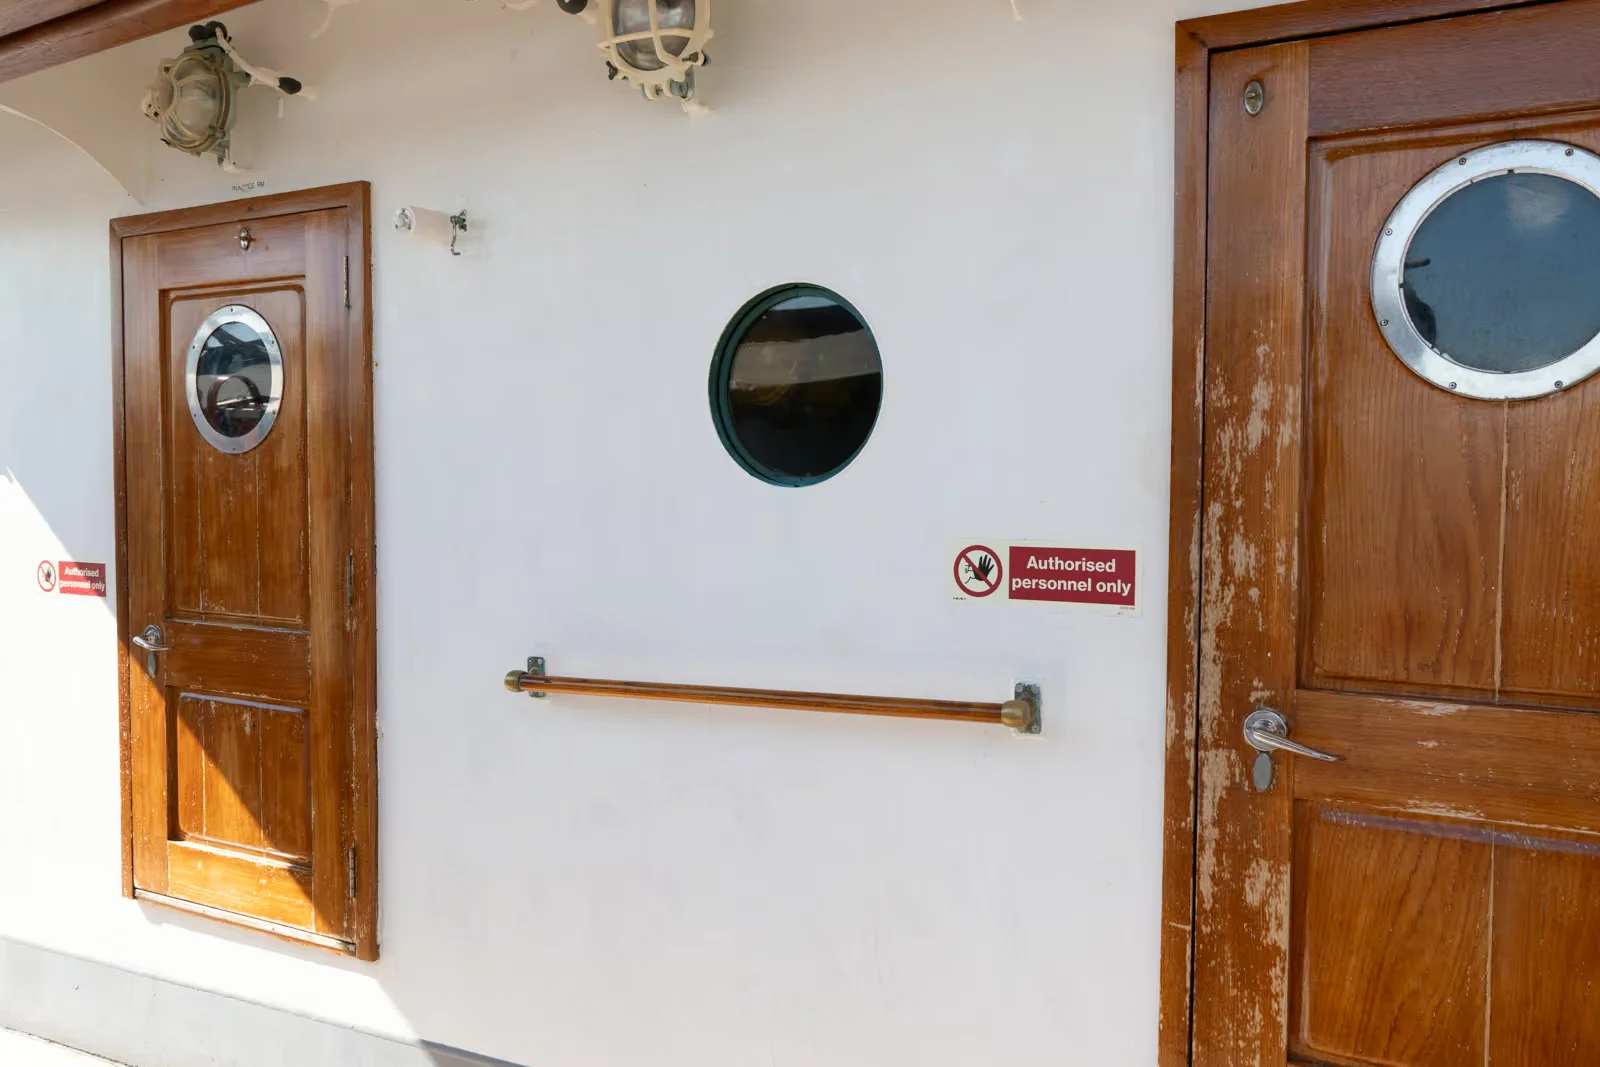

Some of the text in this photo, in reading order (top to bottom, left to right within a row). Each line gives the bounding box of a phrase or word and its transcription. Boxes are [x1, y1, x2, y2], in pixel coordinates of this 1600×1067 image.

[1026, 555, 1116, 573] Authorised
[64, 566, 99, 577] Authorised
[91, 581, 105, 592] only
[1012, 577, 1132, 597] personnel only
